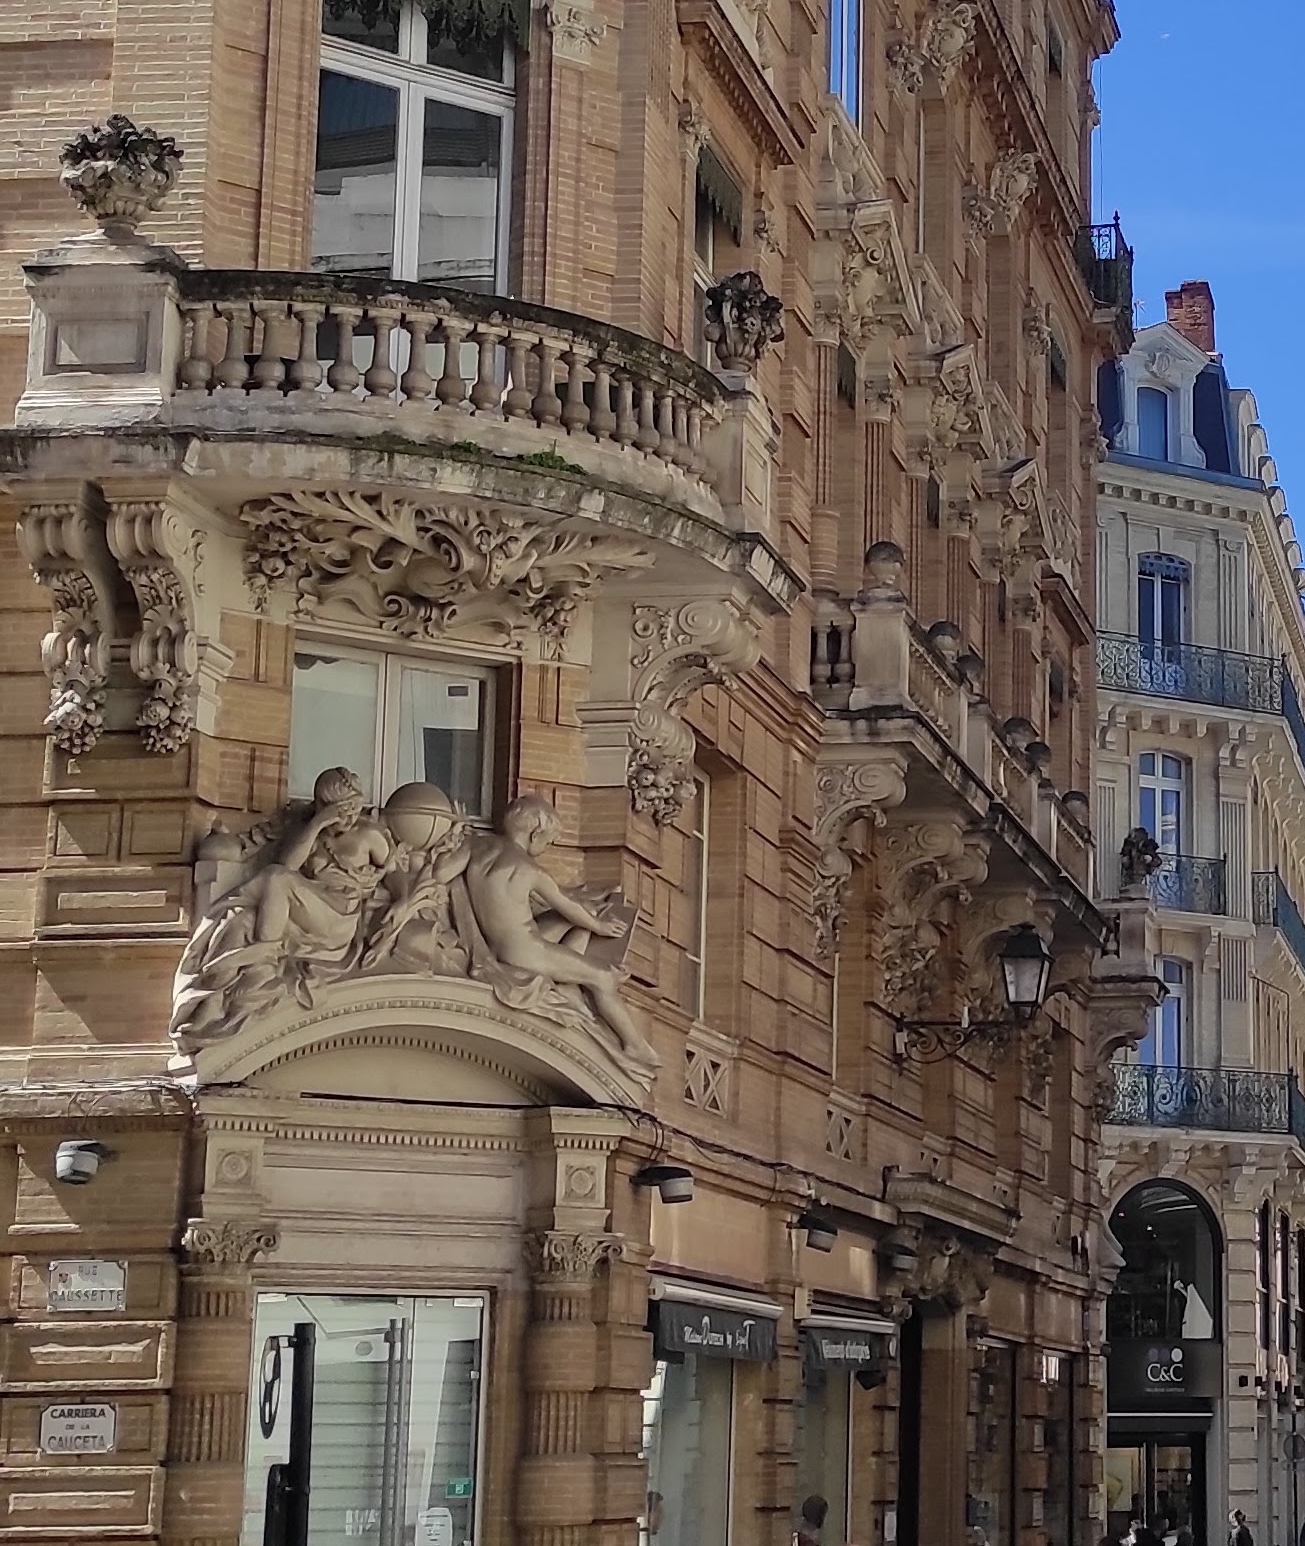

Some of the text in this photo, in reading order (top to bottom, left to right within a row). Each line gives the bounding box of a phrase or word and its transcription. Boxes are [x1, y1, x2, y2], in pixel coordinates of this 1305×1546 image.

[78, 1265, 98, 1276] RUE
[49, 1290, 124, 1302] CAUSSETTE
[1147, 1363, 1183, 1382] C&C
[50, 1408, 106, 1419] CARRIERA
